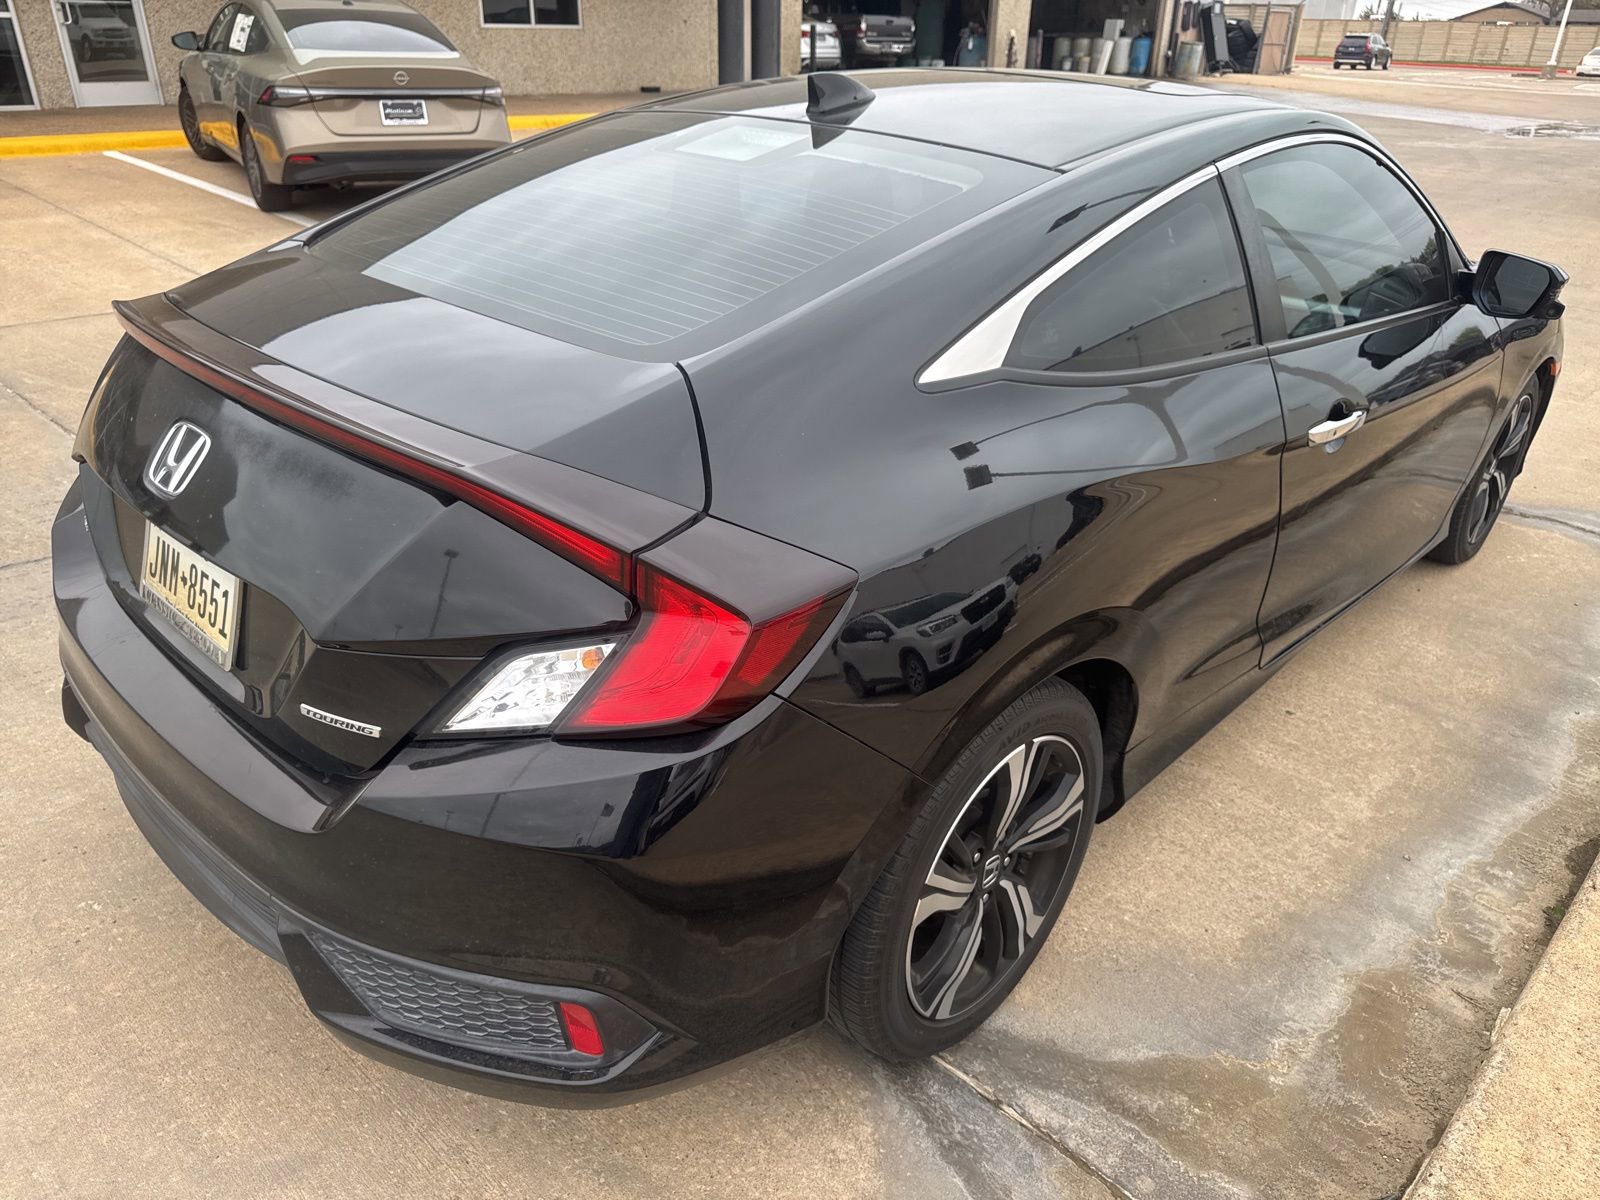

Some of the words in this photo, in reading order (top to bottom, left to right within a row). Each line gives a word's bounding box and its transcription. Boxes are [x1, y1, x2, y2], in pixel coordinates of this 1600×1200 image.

[149, 535, 180, 597] JNM
[187, 563, 230, 640] 8551
[302, 705, 375, 736] TOURING
